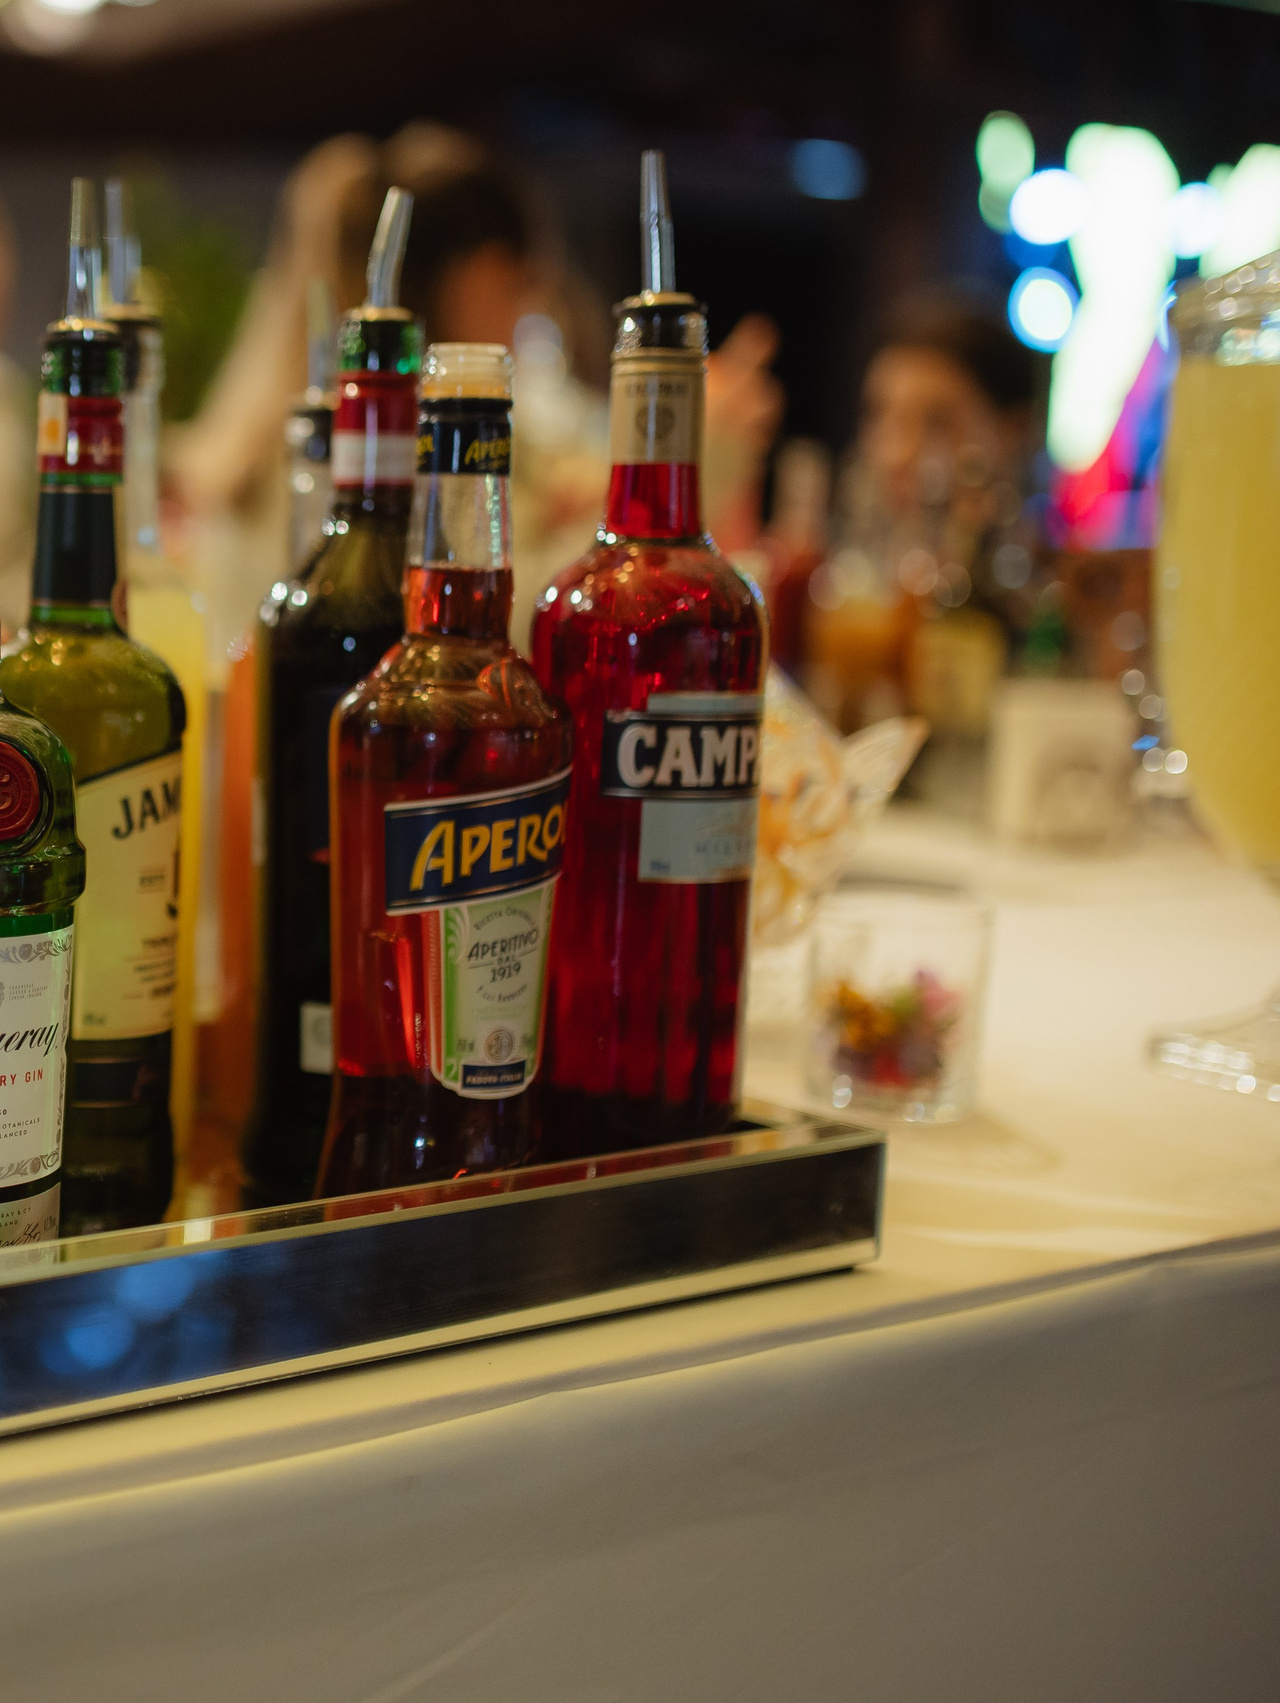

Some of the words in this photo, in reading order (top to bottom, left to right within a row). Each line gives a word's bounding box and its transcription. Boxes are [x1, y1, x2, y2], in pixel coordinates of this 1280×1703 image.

[617, 722, 757, 788] CAMP
[112, 776, 181, 840] JAM
[409, 803, 568, 892] APERO
[468, 928, 539, 962] APERITIVO
[489, 962, 522, 984] 1919
[25, 1068, 43, 1082] GIN
